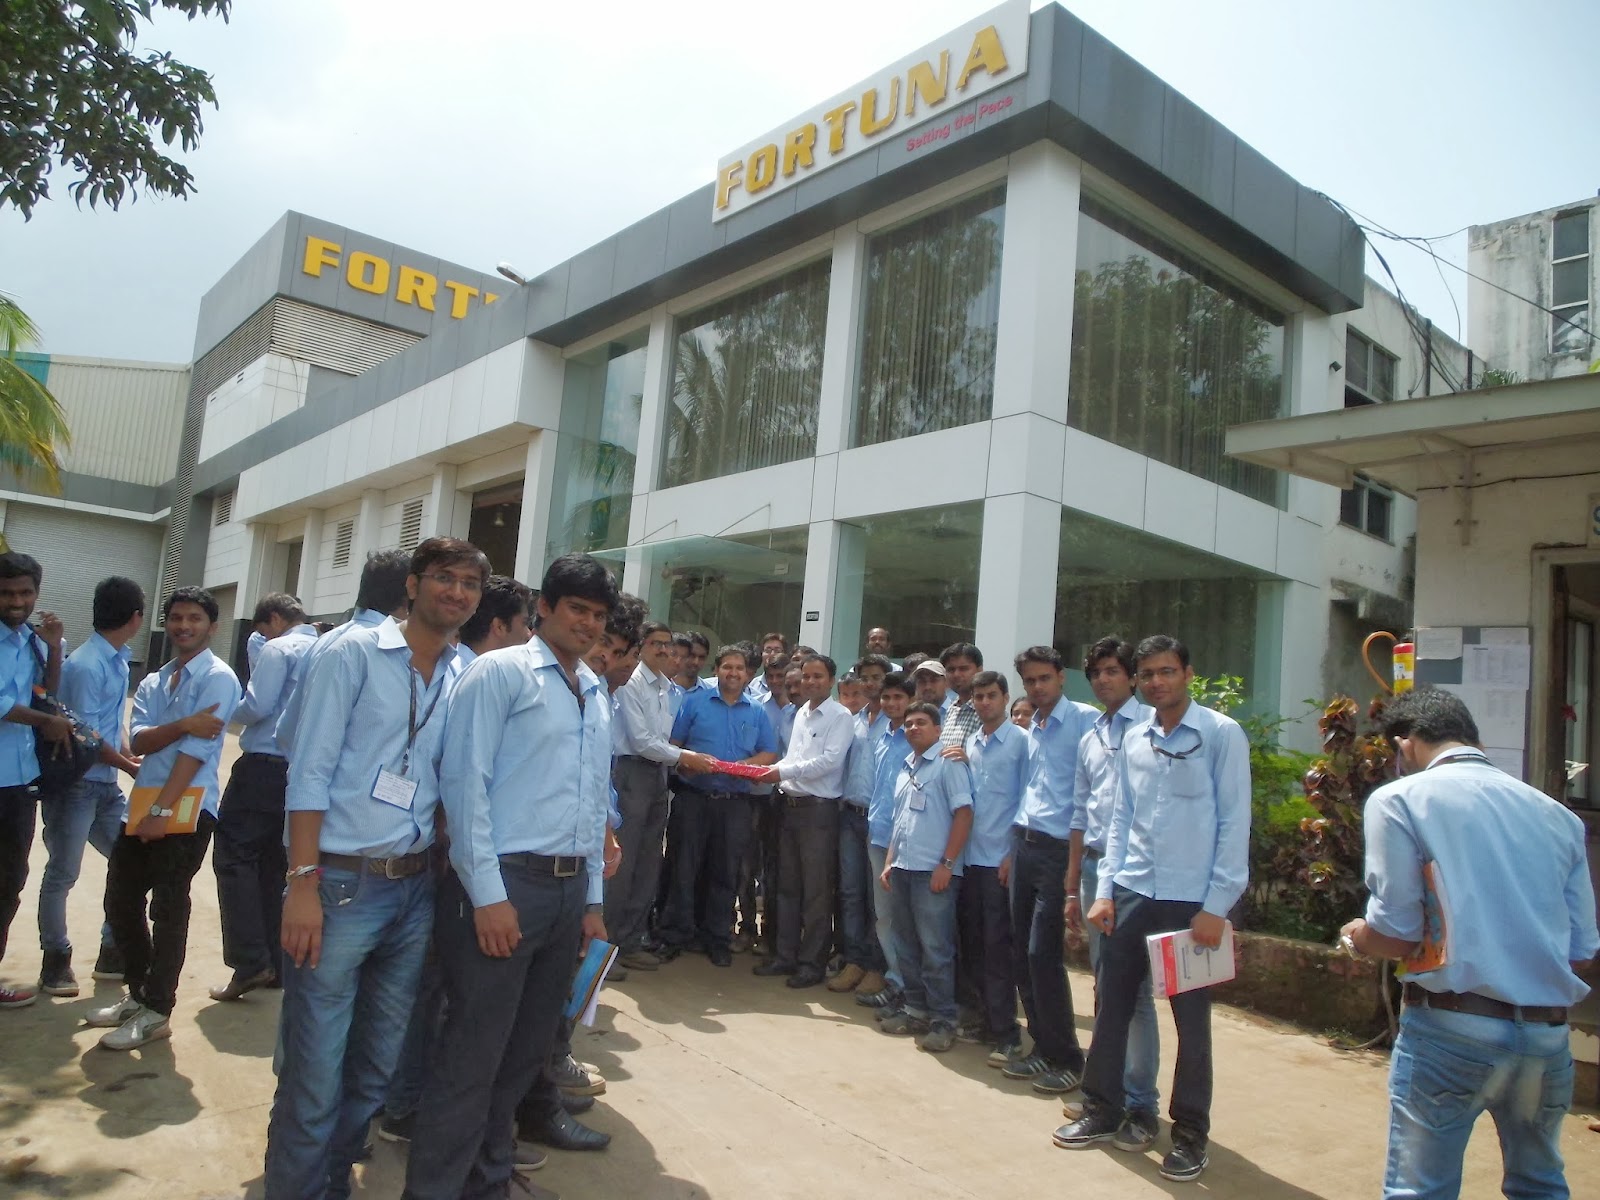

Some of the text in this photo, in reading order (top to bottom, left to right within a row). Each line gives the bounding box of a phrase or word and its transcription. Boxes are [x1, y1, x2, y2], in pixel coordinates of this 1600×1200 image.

[716, 25, 1008, 209] FORTUNA
[906, 97, 1013, 151] Setting the Pace
[303, 235, 499, 319] FORT
